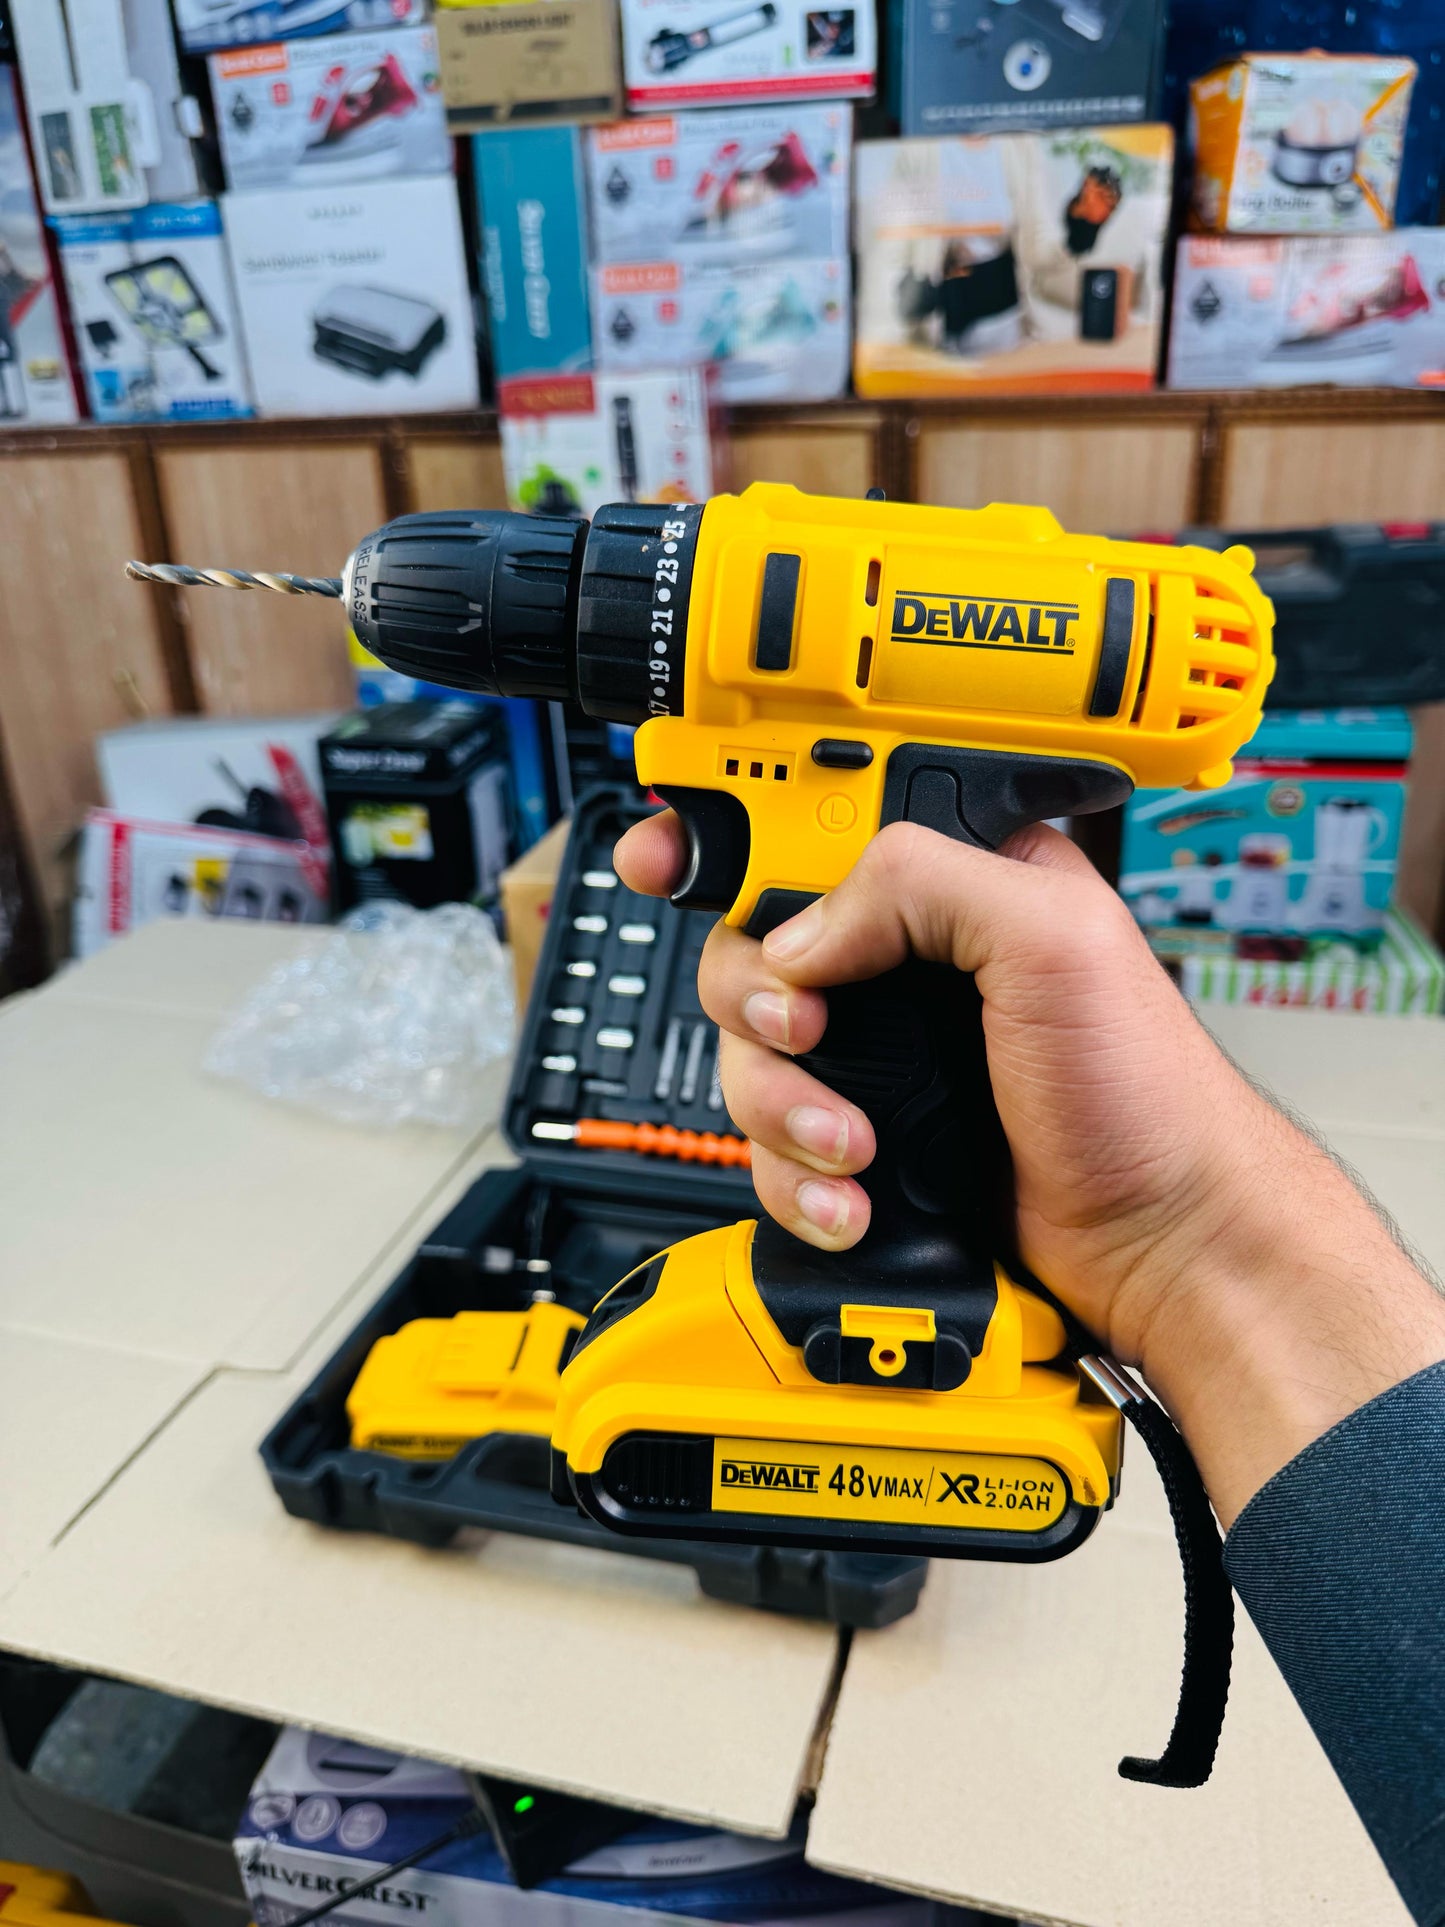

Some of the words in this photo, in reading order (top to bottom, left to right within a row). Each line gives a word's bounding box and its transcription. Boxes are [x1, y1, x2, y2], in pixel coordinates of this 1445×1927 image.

[663, 519, 686, 539] 25
[655, 558, 679, 585] 23
[353, 545, 374, 626] RELEASE
[650, 608, 674, 636] 21
[650, 659, 670, 683] 19
[936, 1471, 983, 1505] XR
[984, 1477, 1055, 1494] LI-ION
[985, 1492, 1051, 1512] 2.0AH
